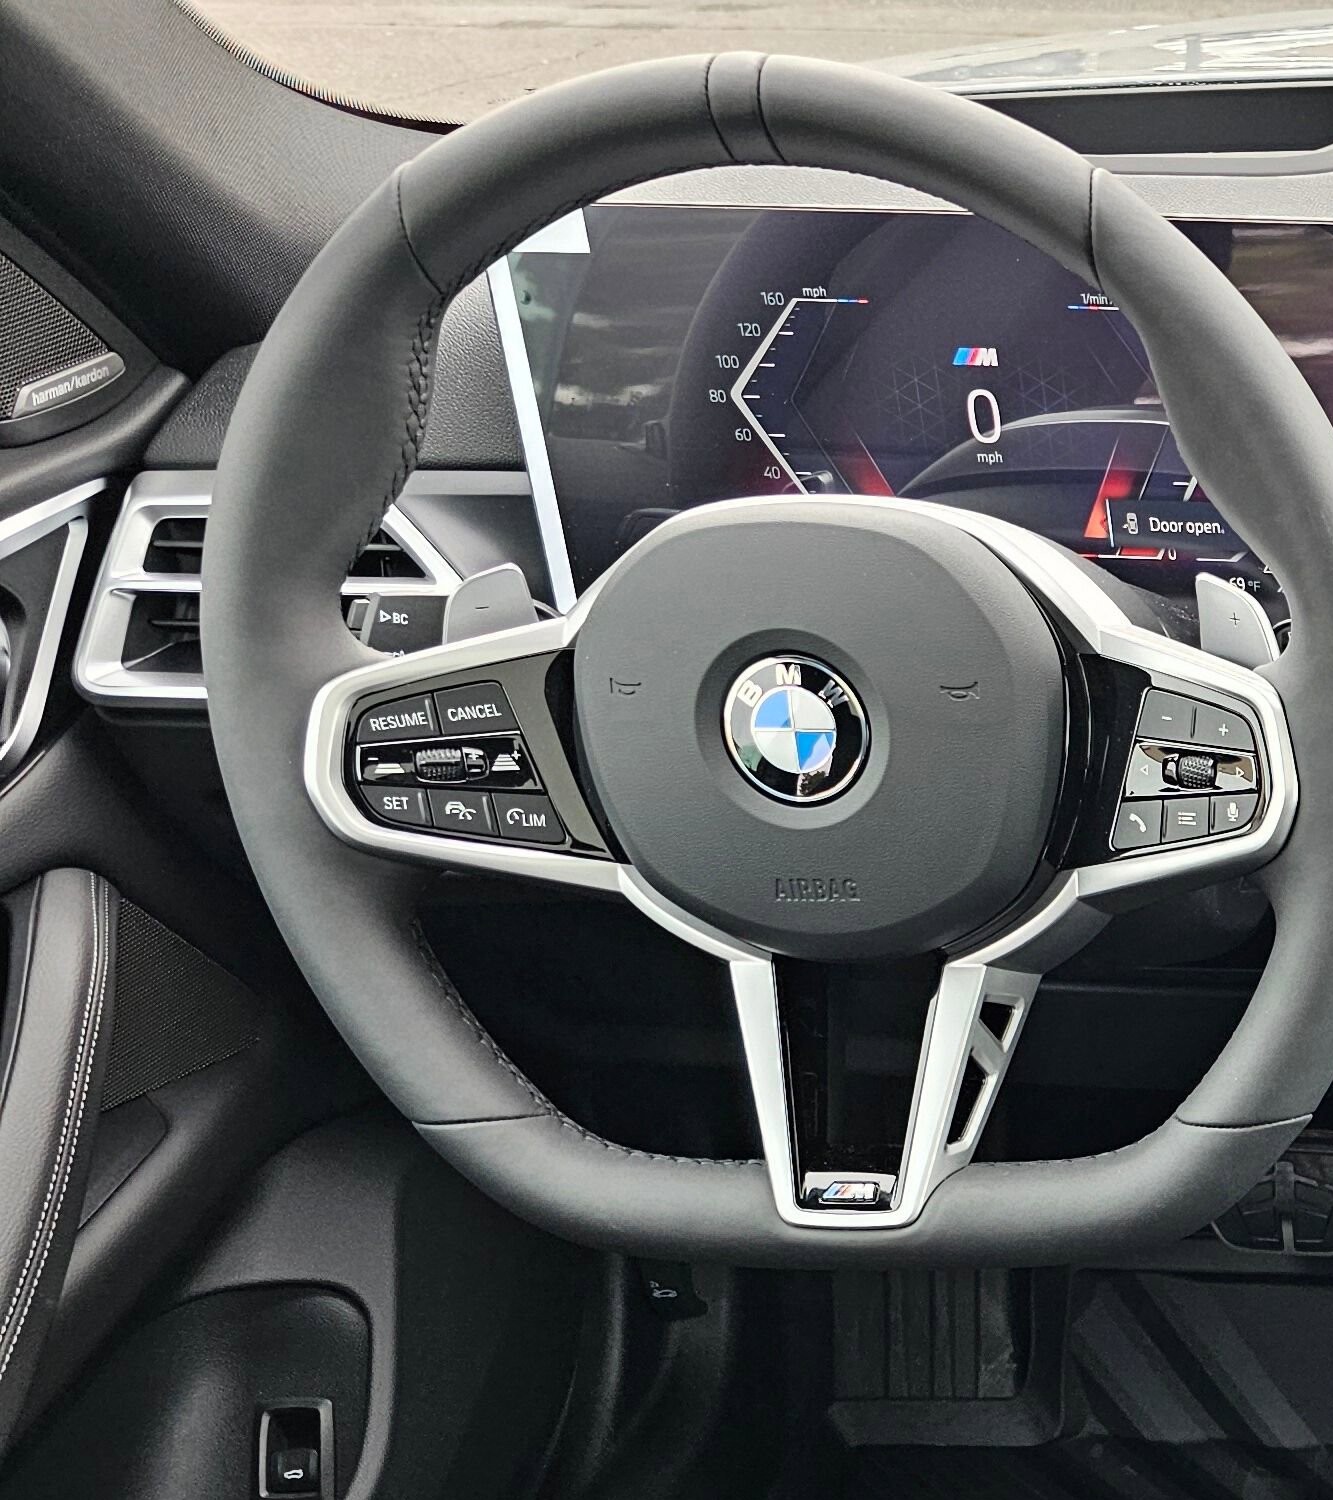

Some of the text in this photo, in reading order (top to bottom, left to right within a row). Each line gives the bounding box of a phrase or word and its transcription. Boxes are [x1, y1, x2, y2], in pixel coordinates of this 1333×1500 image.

[760, 291, 785, 306] 160
[802, 285, 827, 298] mph
[737, 322, 761, 337] 120
[715, 354, 740, 369] 100
[32, 366, 110, 407] harman/kardon
[708, 389, 727, 403] 80
[967, 389, 1002, 444] 0
[735, 428, 752, 442] 60
[977, 450, 1004, 466] mph
[763, 466, 781, 480] 40
[1149, 516, 1183, 533] Door
[392, 611, 409, 625] BC
[736, 663, 850, 709] BMW
[446, 703, 503, 723] CANCEL
[369, 711, 428, 732] RESUME
[383, 796, 409, 811] SET
[522, 813, 547, 828] LIM
[774, 878, 861, 902] AIRBAG
